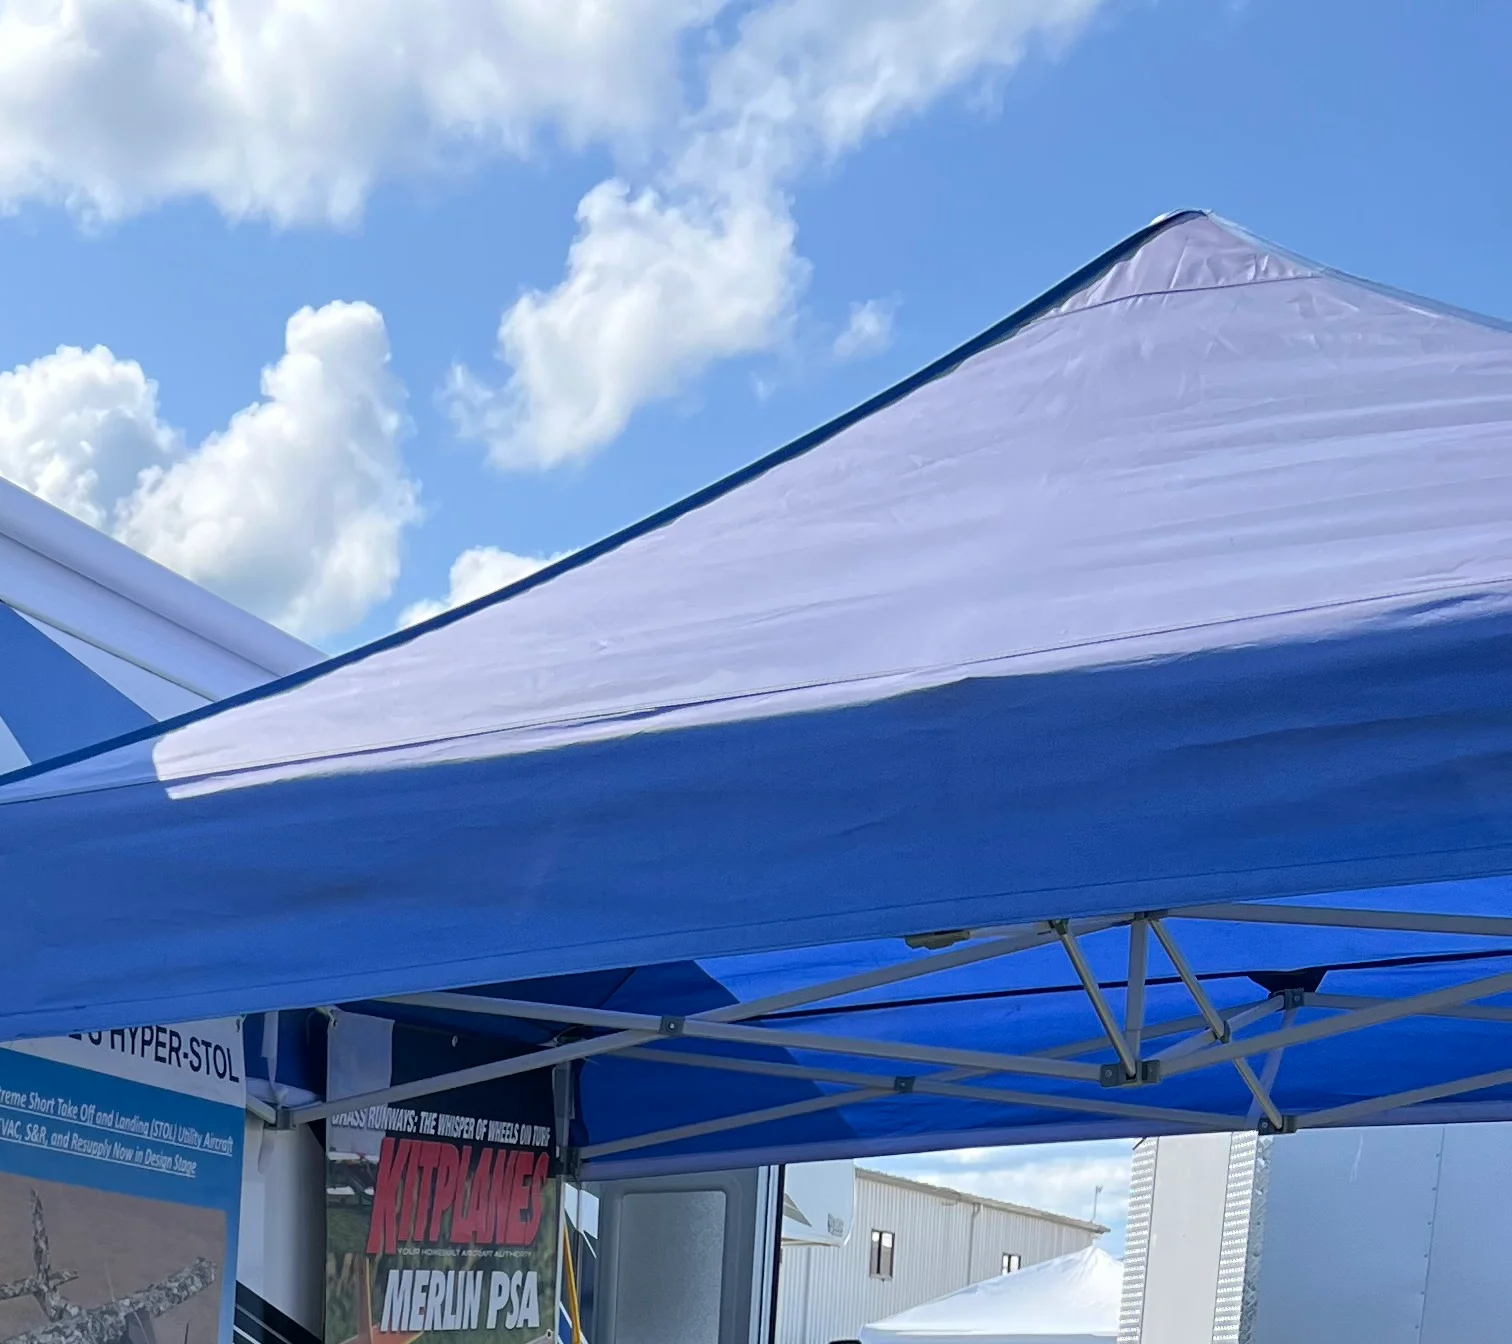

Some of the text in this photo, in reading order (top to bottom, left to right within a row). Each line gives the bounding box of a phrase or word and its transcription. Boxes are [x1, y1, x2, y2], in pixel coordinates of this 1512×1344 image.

[111, 1025, 240, 1084] HYPER-STOL
[25, 1124, 48, 1148] S&R,
[51, 1130, 70, 1148] and
[72, 1132, 112, 1159] Resupply
[113, 1140, 133, 1160] Now
[135, 1145, 144, 1162] in
[144, 1149, 173, 1170] Design
[173, 1154, 197, 1174] Stage
[29, 1092, 55, 1112] Short
[58, 1097, 78, 1119] Take
[80, 1103, 96, 1125] Off
[96, 1110, 114, 1128] and
[115, 1111, 149, 1137] Landing
[150, 1118, 177, 1143] (STOL)
[178, 1128, 202, 1148] Utility
[203, 1131, 234, 1154] Aircraft
[367, 1104, 418, 1133] RUNWAYS:
[419, 1111, 437, 1136] THE
[437, 1113, 476, 1140] WHISPER
[476, 1119, 487, 1141] OF
[487, 1120, 520, 1145] WHEELS
[520, 1124, 532, 1146] ON
[532, 1126, 551, 1148] TURF
[366, 1136, 550, 1254] KITPLANES
[397, 1247, 421, 1256] YOUR
[381, 1269, 540, 1332] MERLIN PSA
